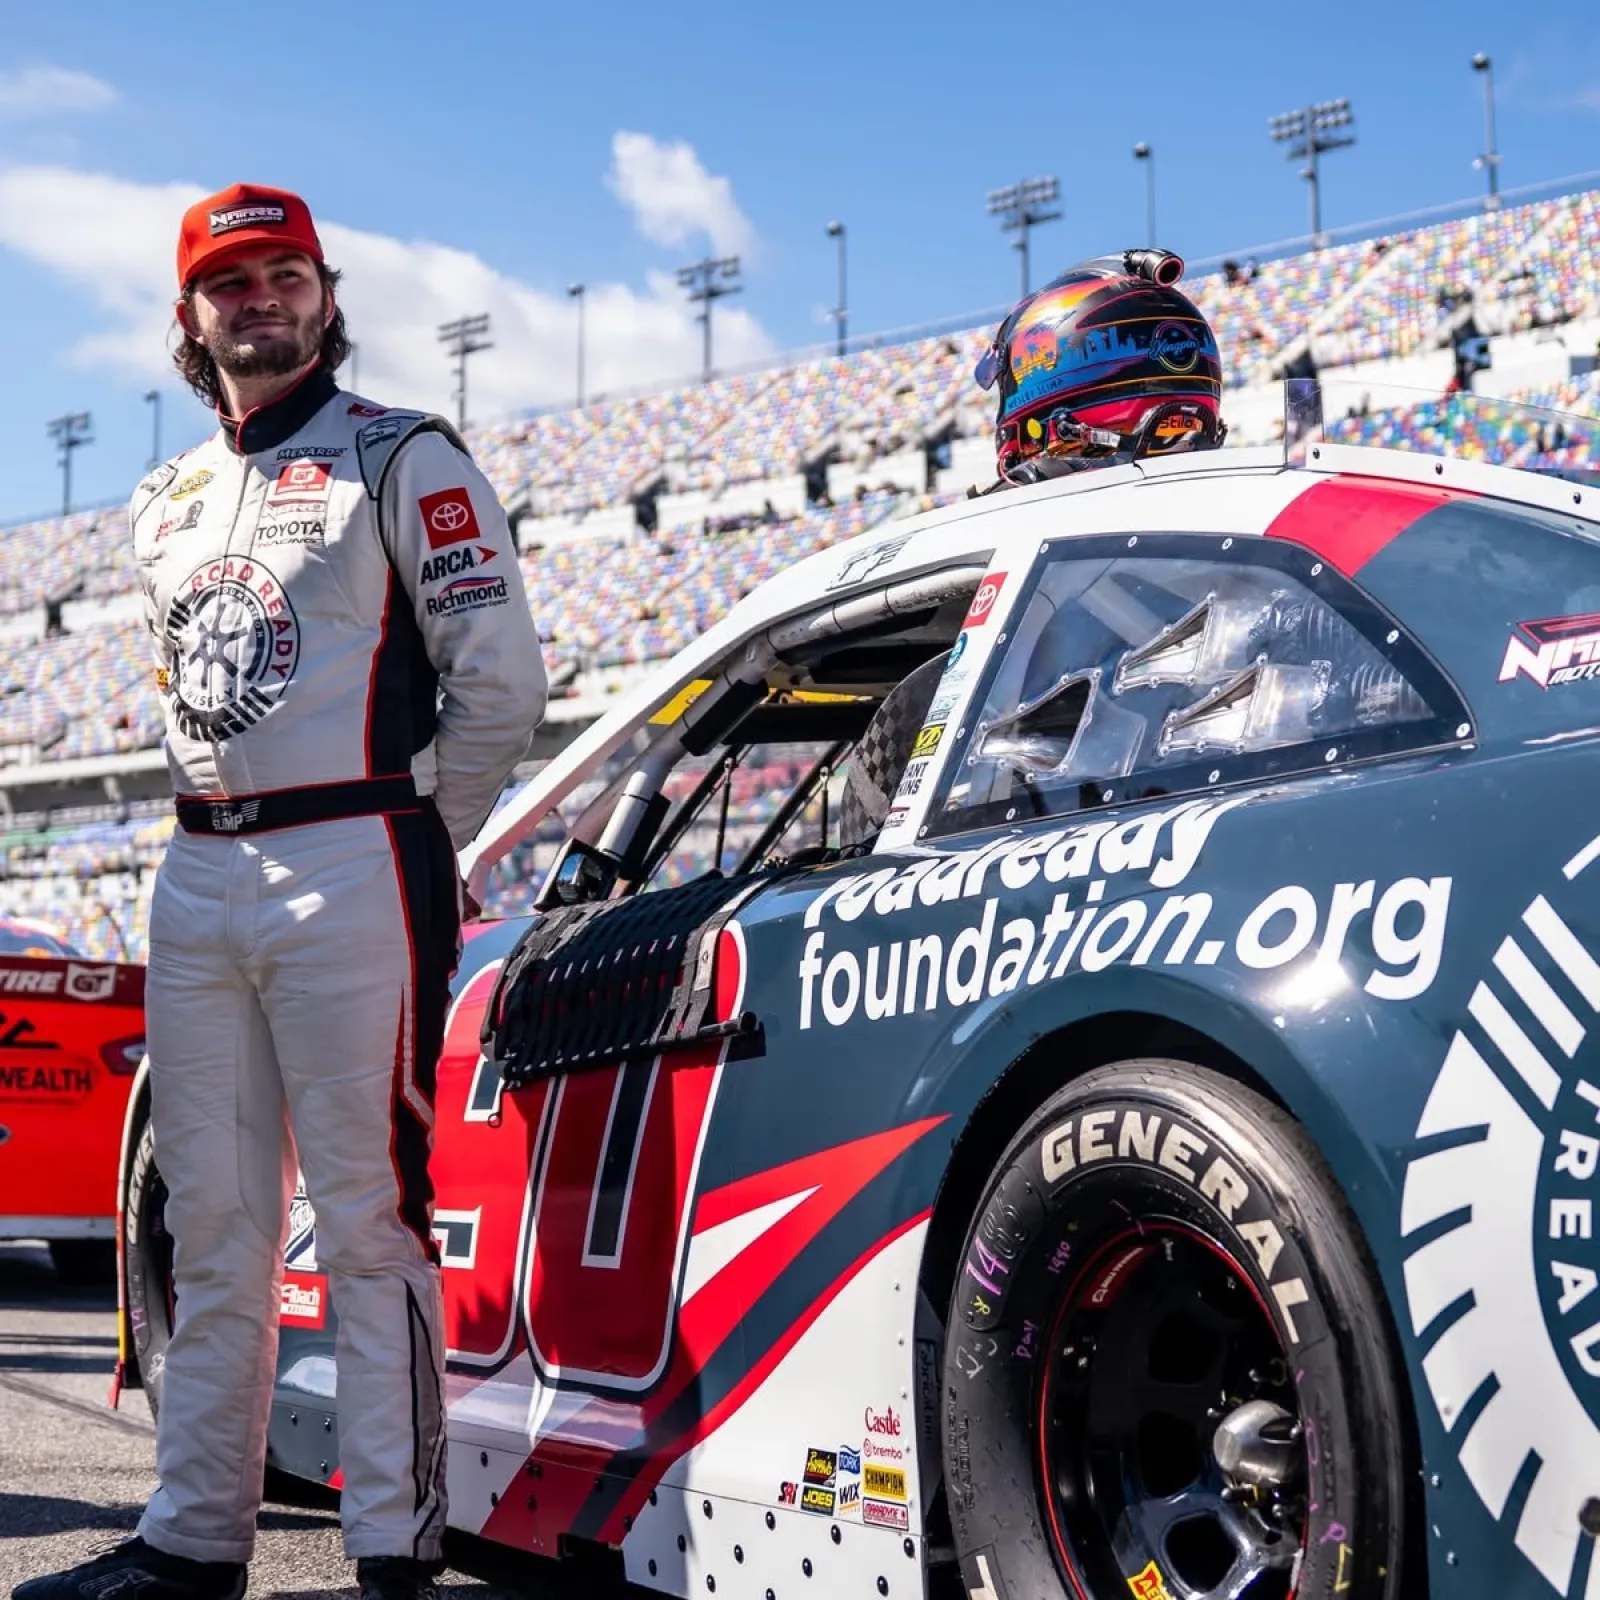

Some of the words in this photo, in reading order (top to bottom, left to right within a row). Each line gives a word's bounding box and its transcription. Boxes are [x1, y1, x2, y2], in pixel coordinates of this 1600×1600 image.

[276, 447, 342, 460] MENARDS
[257, 520, 326, 540] TOYOTA
[420, 547, 475, 585] ARCA
[427, 576, 507, 615] Richmond
[257, 578, 294, 680] READY
[804, 797, 1246, 929] roadready
[800, 876, 1452, 1030] foundation.org
[1040, 1110, 1310, 1346] GENERAL
[865, 1405, 900, 1436] Castle
[873, 1444, 903, 1461] brembo
[803, 1489, 833, 1508] JOES
[840, 1482, 860, 1505] WIX
